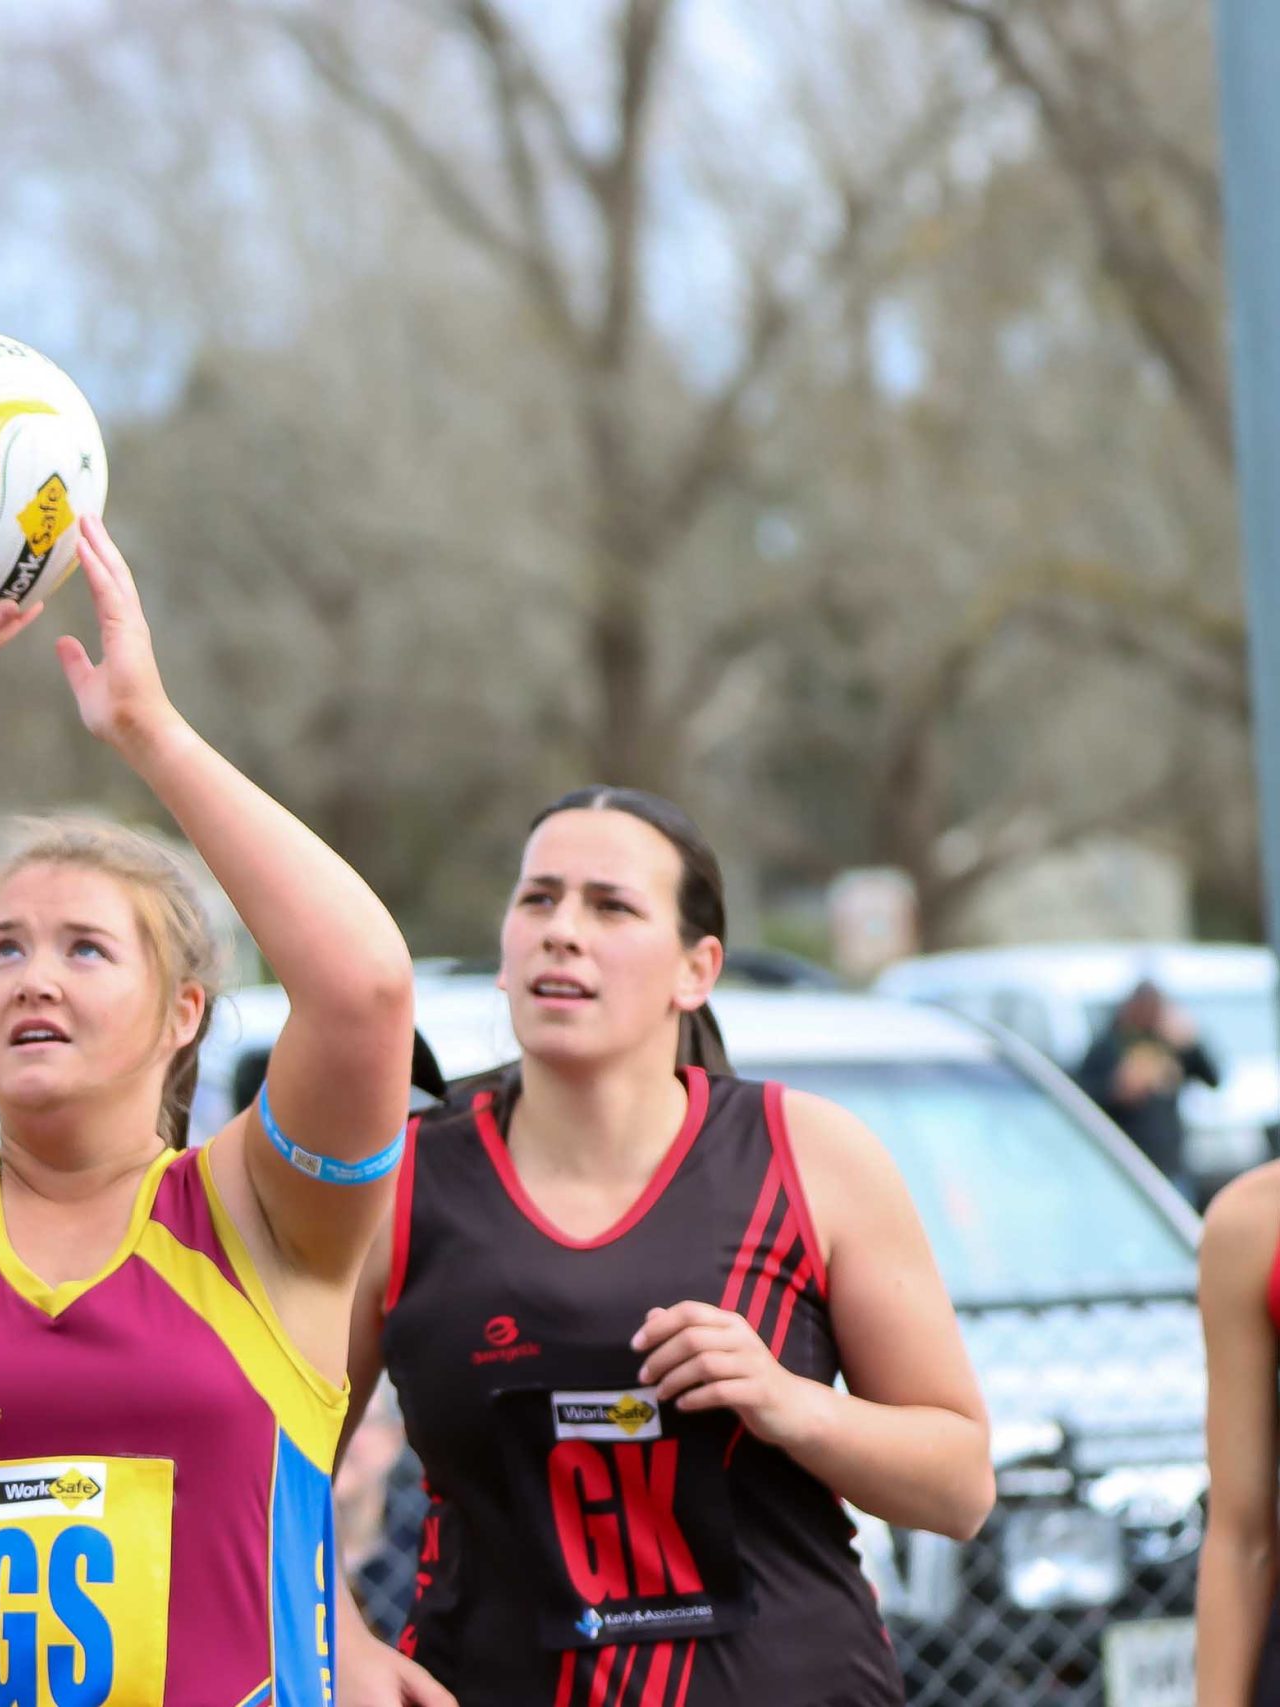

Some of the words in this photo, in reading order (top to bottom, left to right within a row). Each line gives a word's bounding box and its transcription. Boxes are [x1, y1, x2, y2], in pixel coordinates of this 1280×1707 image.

[562, 1402, 648, 1422] WorkSafe
[5, 1479, 93, 1501] WorkSafe
[548, 1439, 704, 1606] GK
